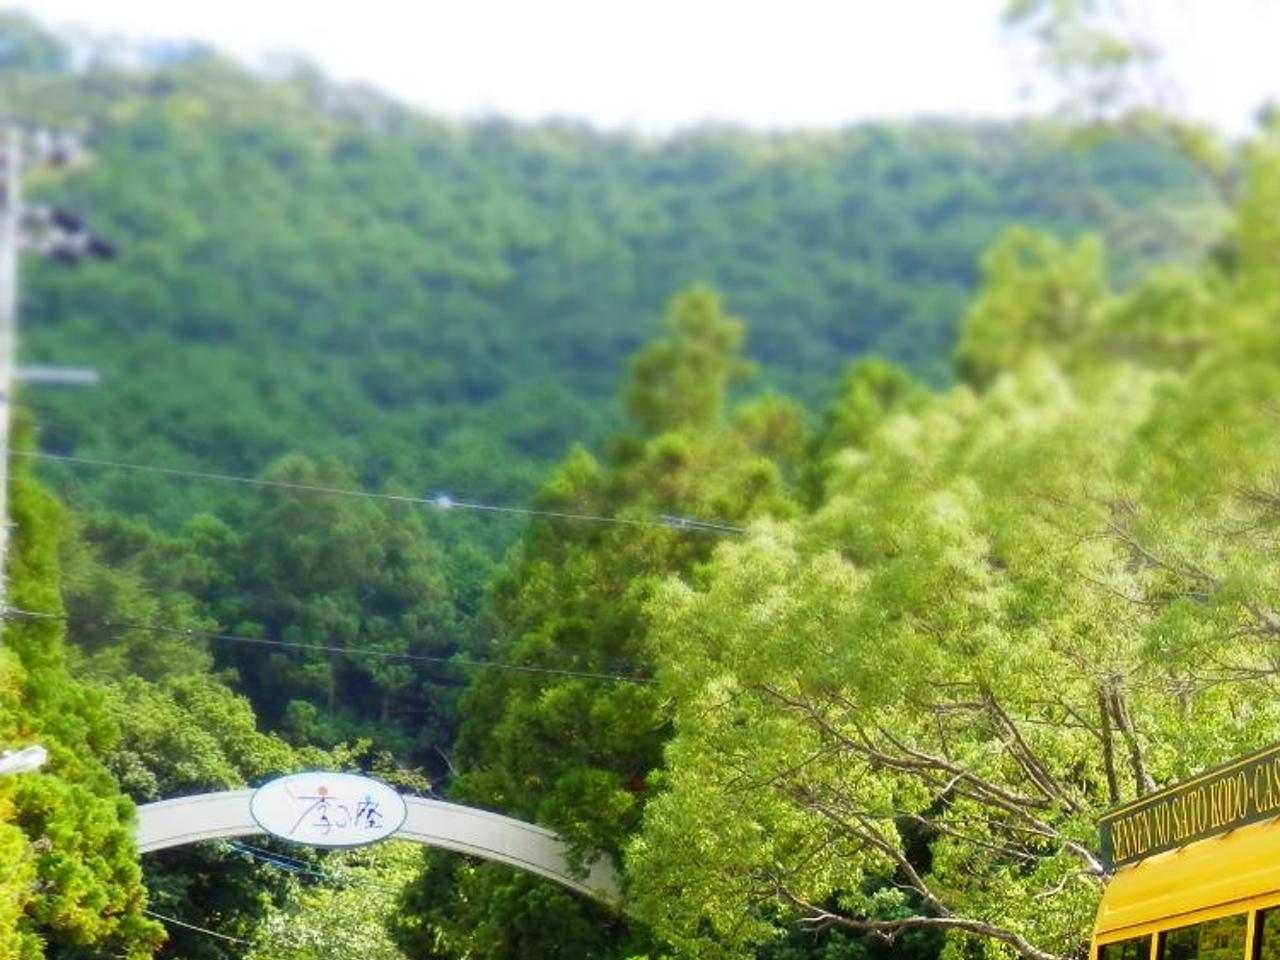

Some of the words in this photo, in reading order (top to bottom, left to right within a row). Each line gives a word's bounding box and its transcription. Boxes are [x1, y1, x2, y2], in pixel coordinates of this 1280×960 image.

[1111, 808, 1152, 862] SENNEN
[1154, 805, 1172, 847] NO
[1173, 786, 1206, 842] SATO
